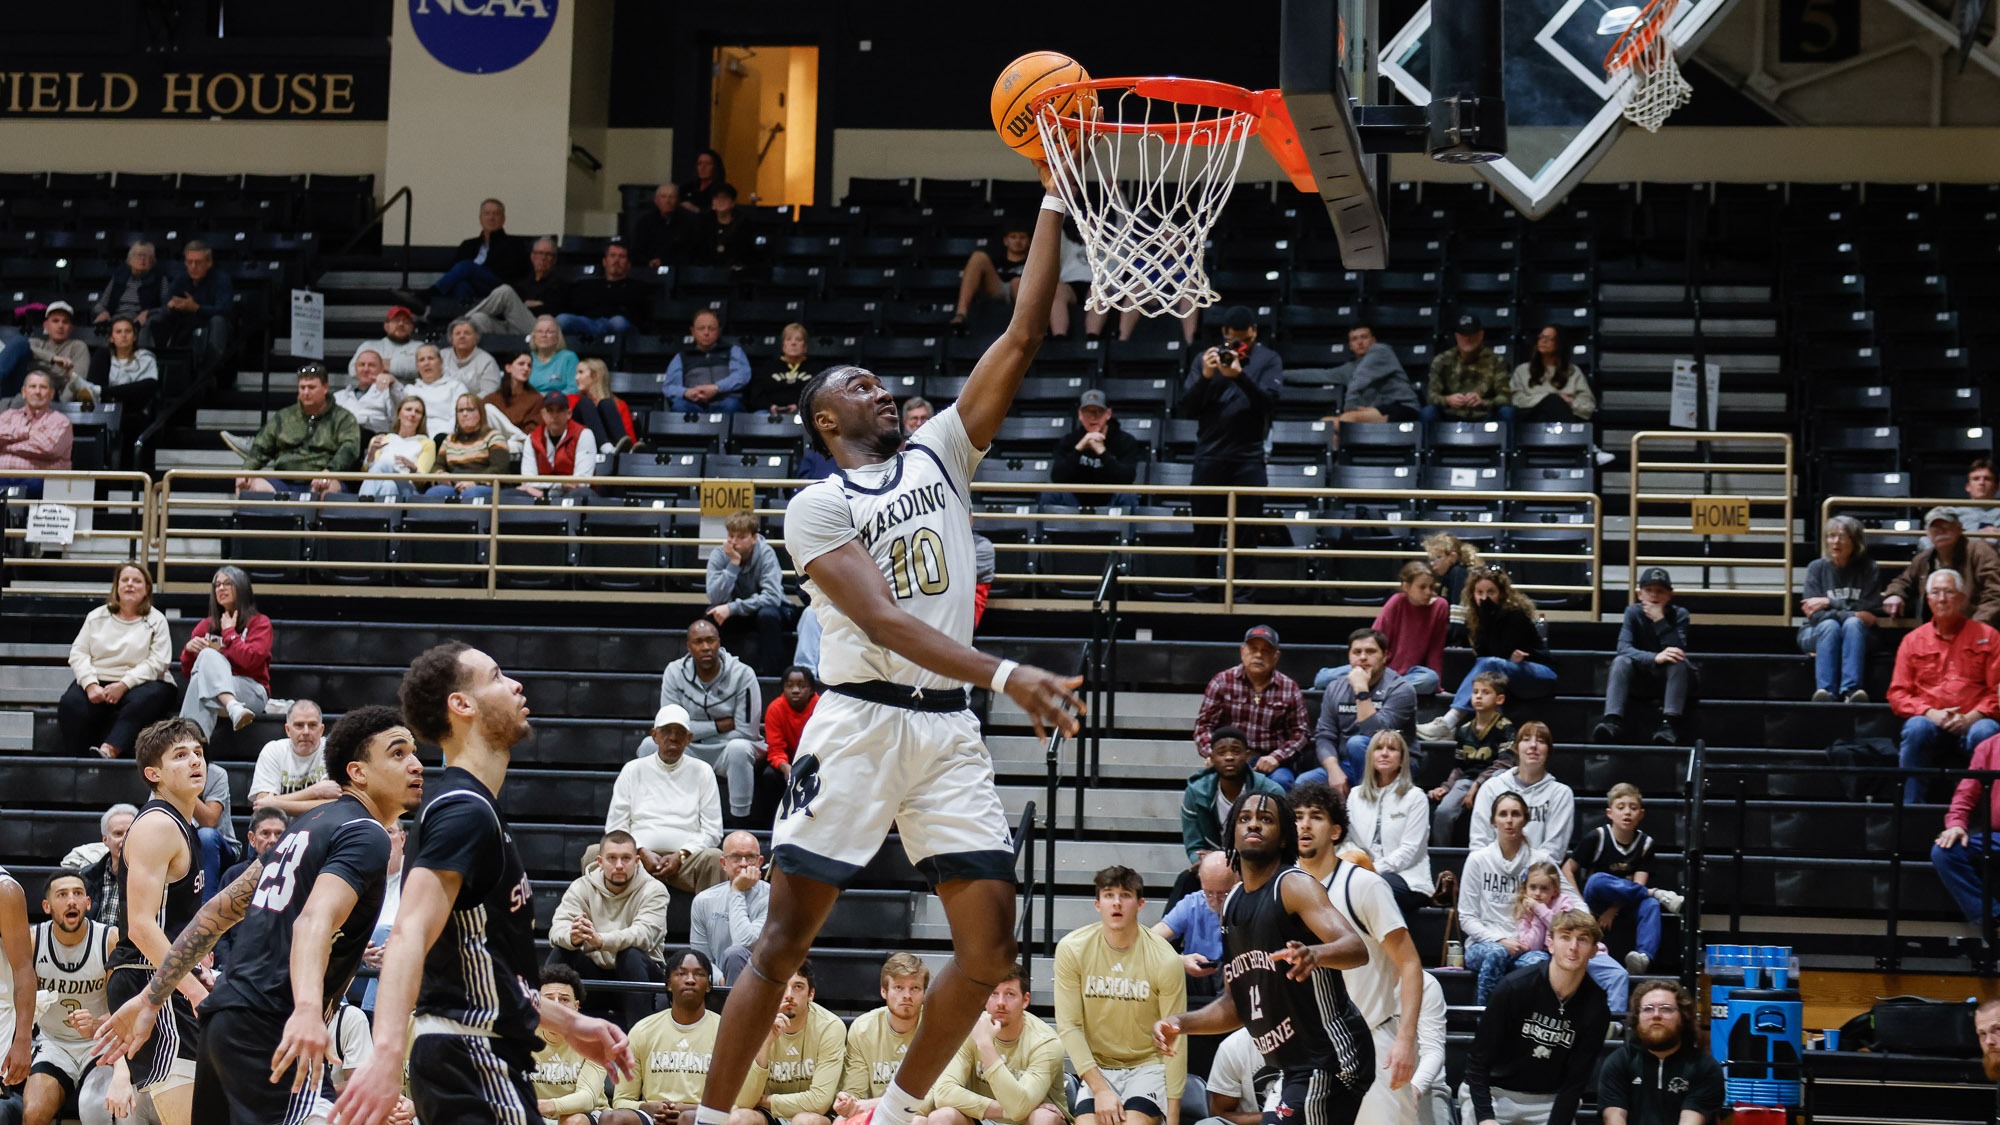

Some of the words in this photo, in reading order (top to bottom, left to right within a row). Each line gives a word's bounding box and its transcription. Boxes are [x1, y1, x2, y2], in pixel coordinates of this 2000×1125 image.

[0, 72, 138, 112] IELD
[161, 73, 355, 114] HOUSE
[704, 487, 751, 509] HOME
[860, 482, 946, 550] HARDING
[1696, 505, 1747, 527] HOME
[889, 526, 949, 599] 10
[251, 830, 311, 912] 23
[37, 977, 104, 994] HARDING
[60, 999, 82, 1028] 3
[1522, 1022, 1571, 1044] BASKETBALL
